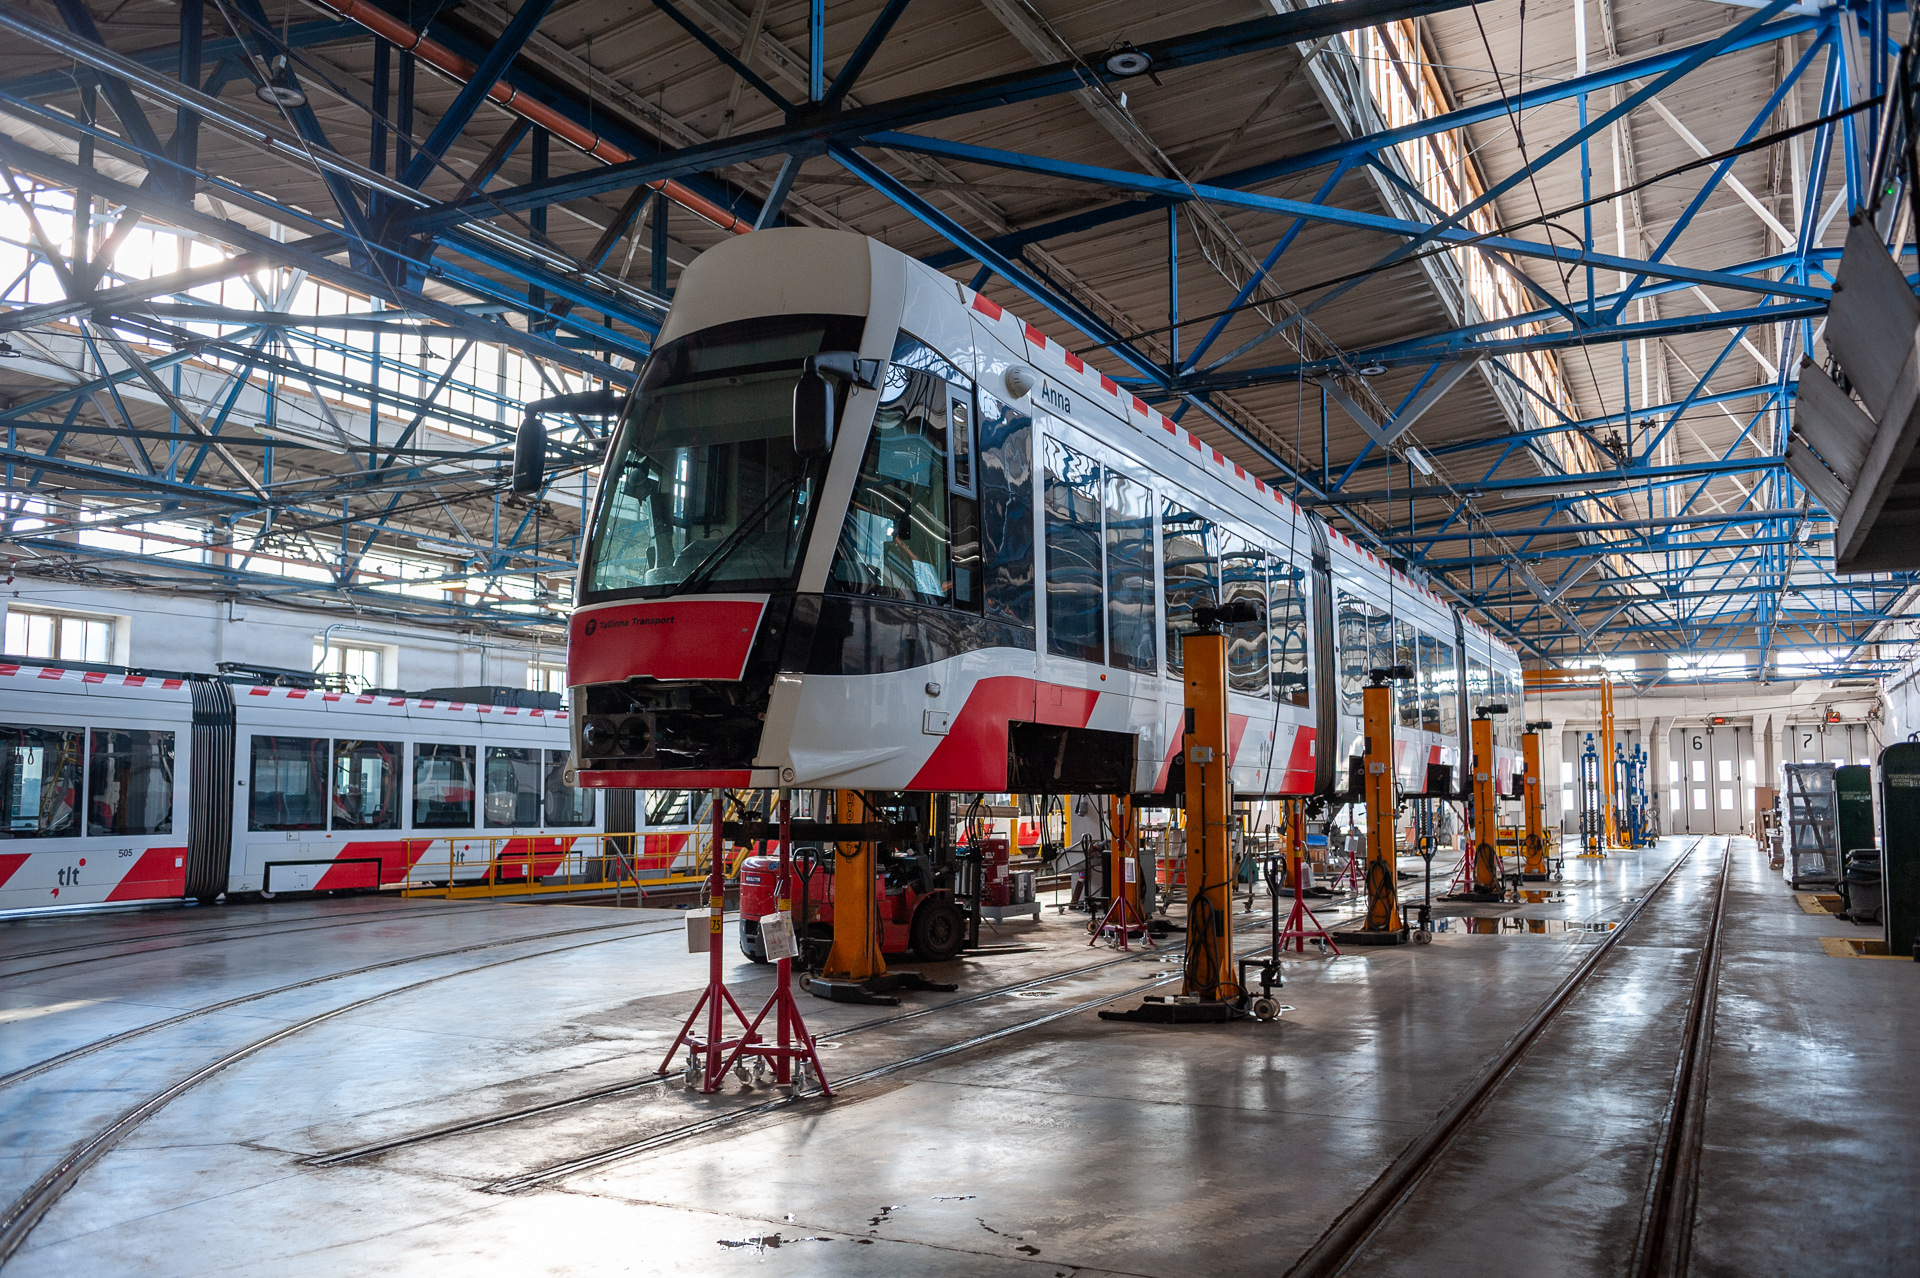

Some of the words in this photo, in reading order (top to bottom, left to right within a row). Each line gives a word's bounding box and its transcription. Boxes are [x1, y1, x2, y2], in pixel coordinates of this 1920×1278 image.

[1041, 378, 1071, 415] Anna
[599, 618, 629, 630] Tallinna
[632, 615, 675, 627] Transport
[1692, 735, 1703, 750] 6
[1802, 733, 1813, 748] 7
[948, 815, 958, 847] HELI
[118, 848, 133, 858] 505
[57, 866, 80, 886] tlt
